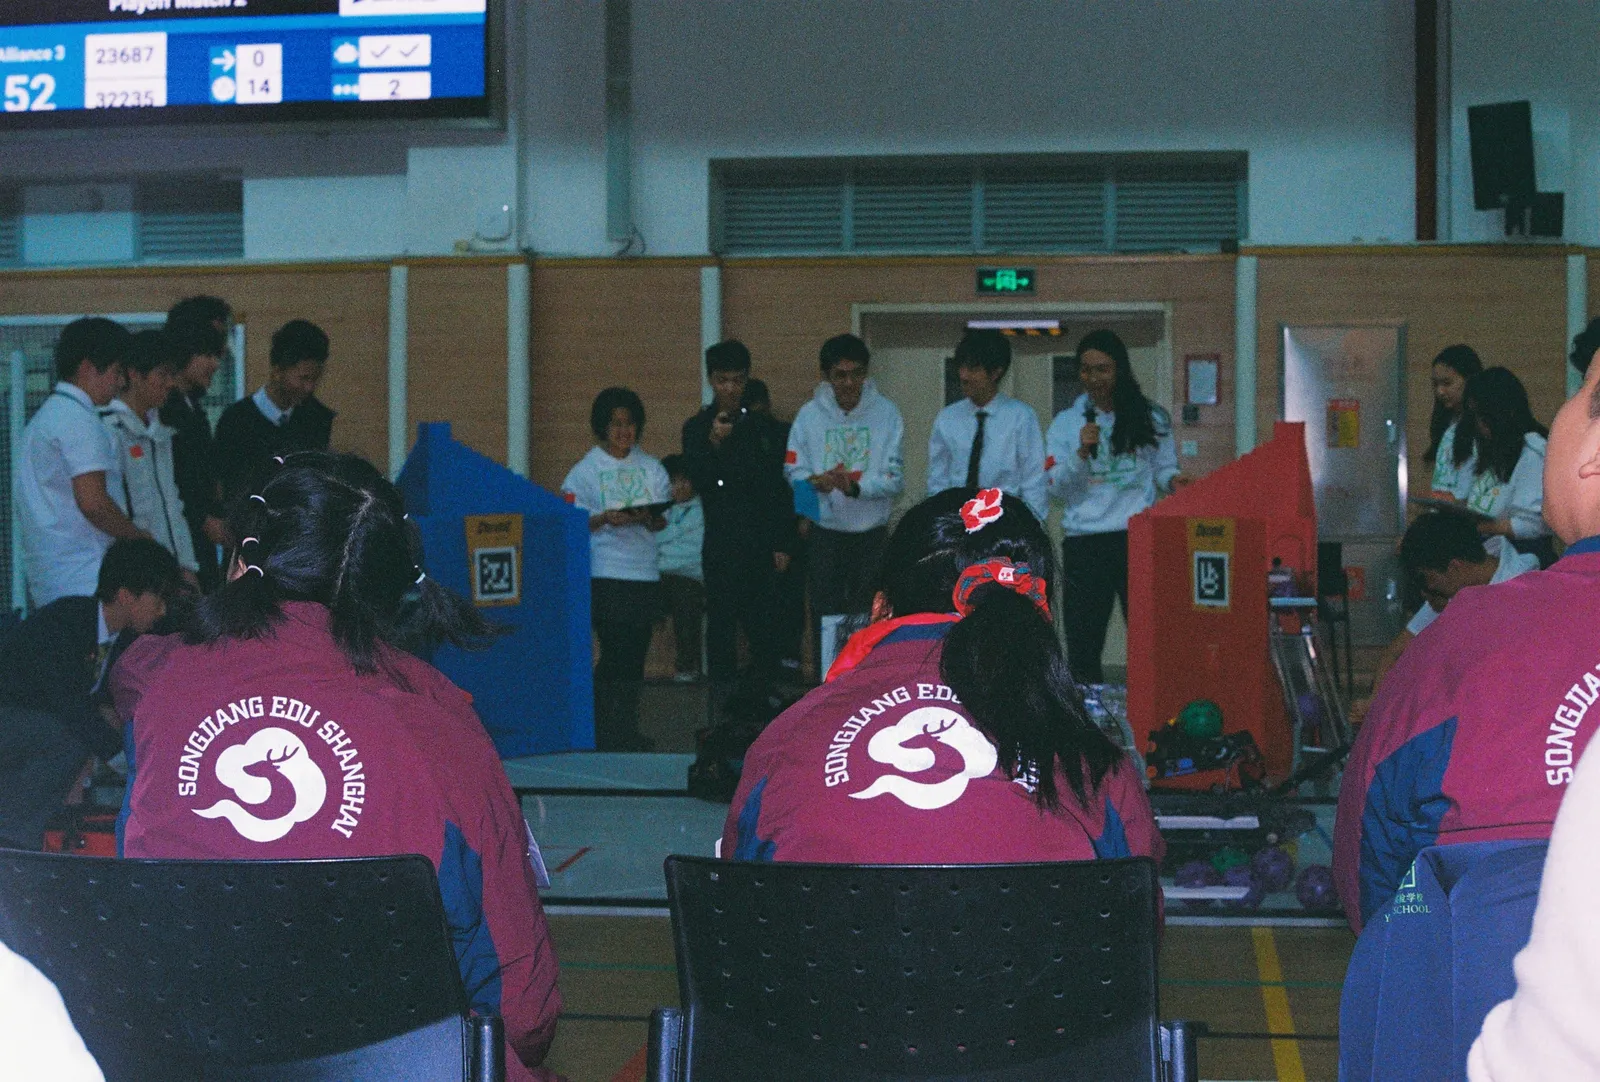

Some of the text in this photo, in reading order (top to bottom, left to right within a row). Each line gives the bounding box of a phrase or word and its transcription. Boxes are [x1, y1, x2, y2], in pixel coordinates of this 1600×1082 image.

[54, 44, 66, 61] 3
[96, 46, 154, 65] 23687
[253, 50, 265, 68] 0
[4, 73, 57, 112] 52
[249, 79, 270, 96] 14
[388, 79, 401, 98] 2
[96, 91, 155, 108] 32235
[1545, 663, 1600, 786] SONGJIA
[825, 685, 912, 787] SONGJIANG
[178, 696, 366, 839] SONGJIANG EDU SHANGHAI
[1393, 904, 1432, 915] SCHOOL
